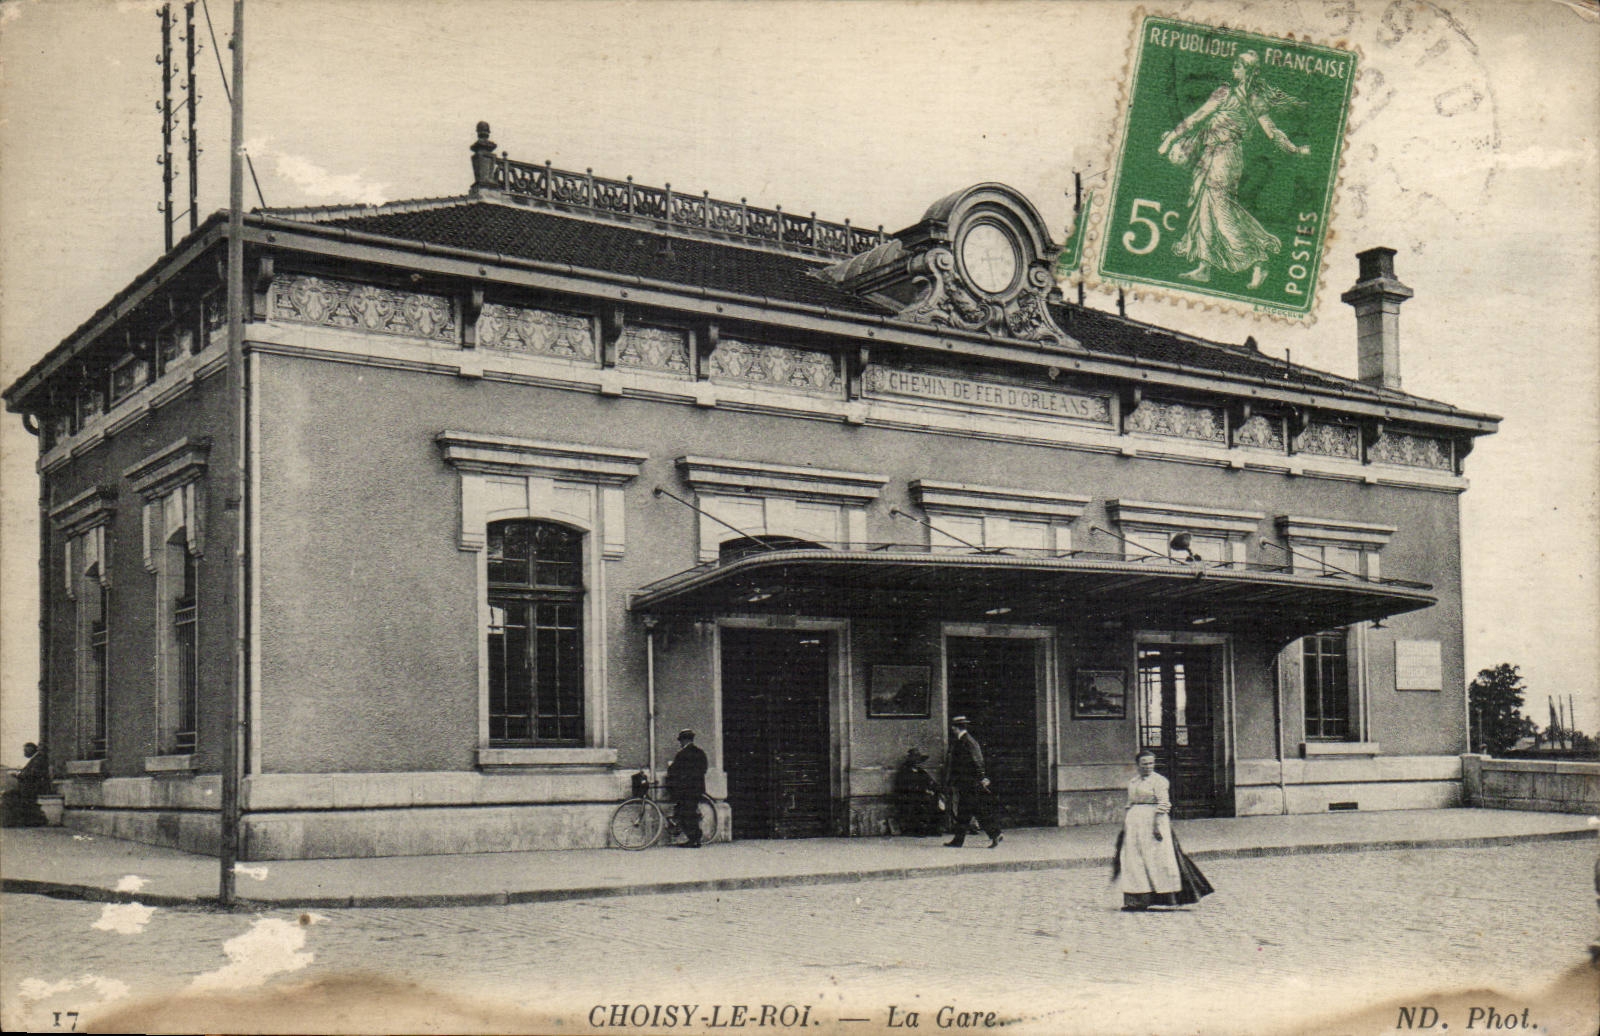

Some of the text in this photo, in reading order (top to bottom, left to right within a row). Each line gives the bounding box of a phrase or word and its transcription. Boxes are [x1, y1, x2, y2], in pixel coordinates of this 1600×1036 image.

[1264, 47, 1346, 79] FRANÇAISE
[1284, 211, 1318, 296] POSTES
[889, 372, 948, 397] CHEMIN
[953, 381, 971, 400] DE
[976, 384, 1004, 405] FER
